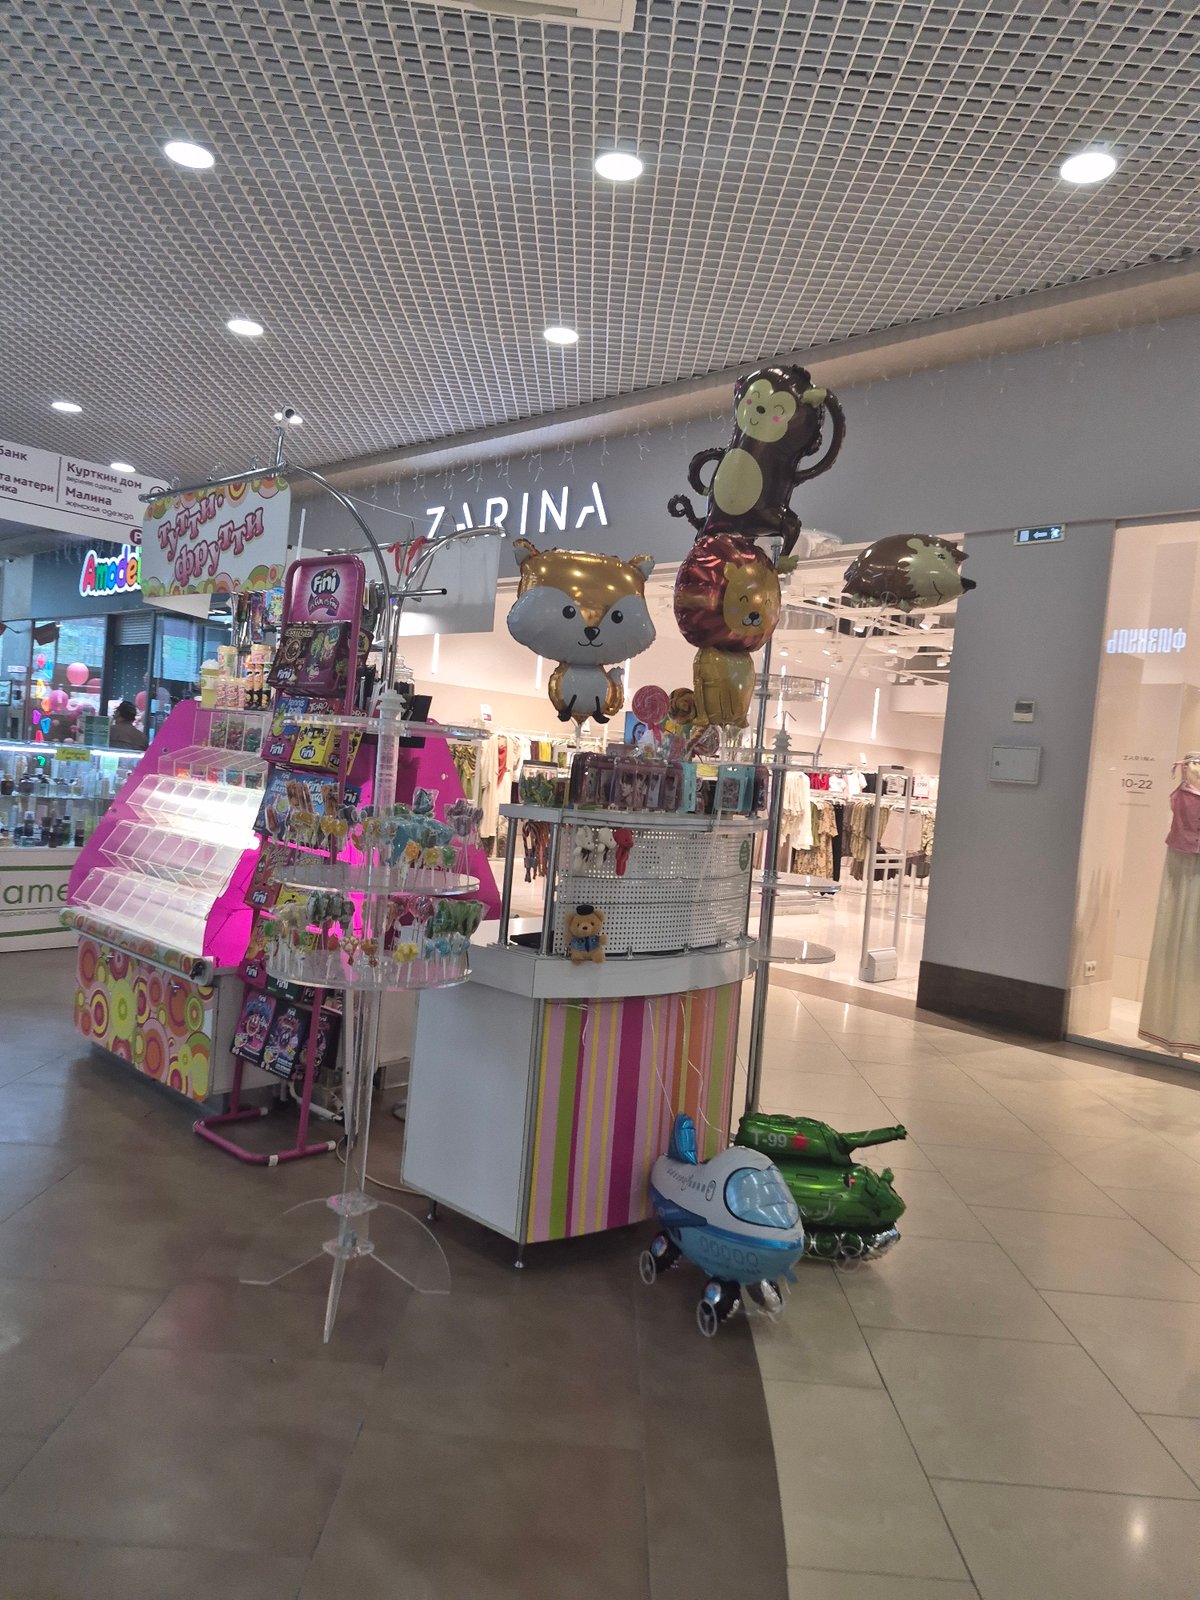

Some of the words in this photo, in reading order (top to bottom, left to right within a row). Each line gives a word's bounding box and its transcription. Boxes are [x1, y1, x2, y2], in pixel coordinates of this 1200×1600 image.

[67, 462, 118, 484] Курткин
[119, 478, 142, 490] дом
[65, 486, 112, 506] Малина
[426, 481, 608, 538] ZARINA
[313, 571, 337, 593] Fini
[1120, 778, 1154, 790] 10-22
[751, 1129, 788, 1148] T-99
